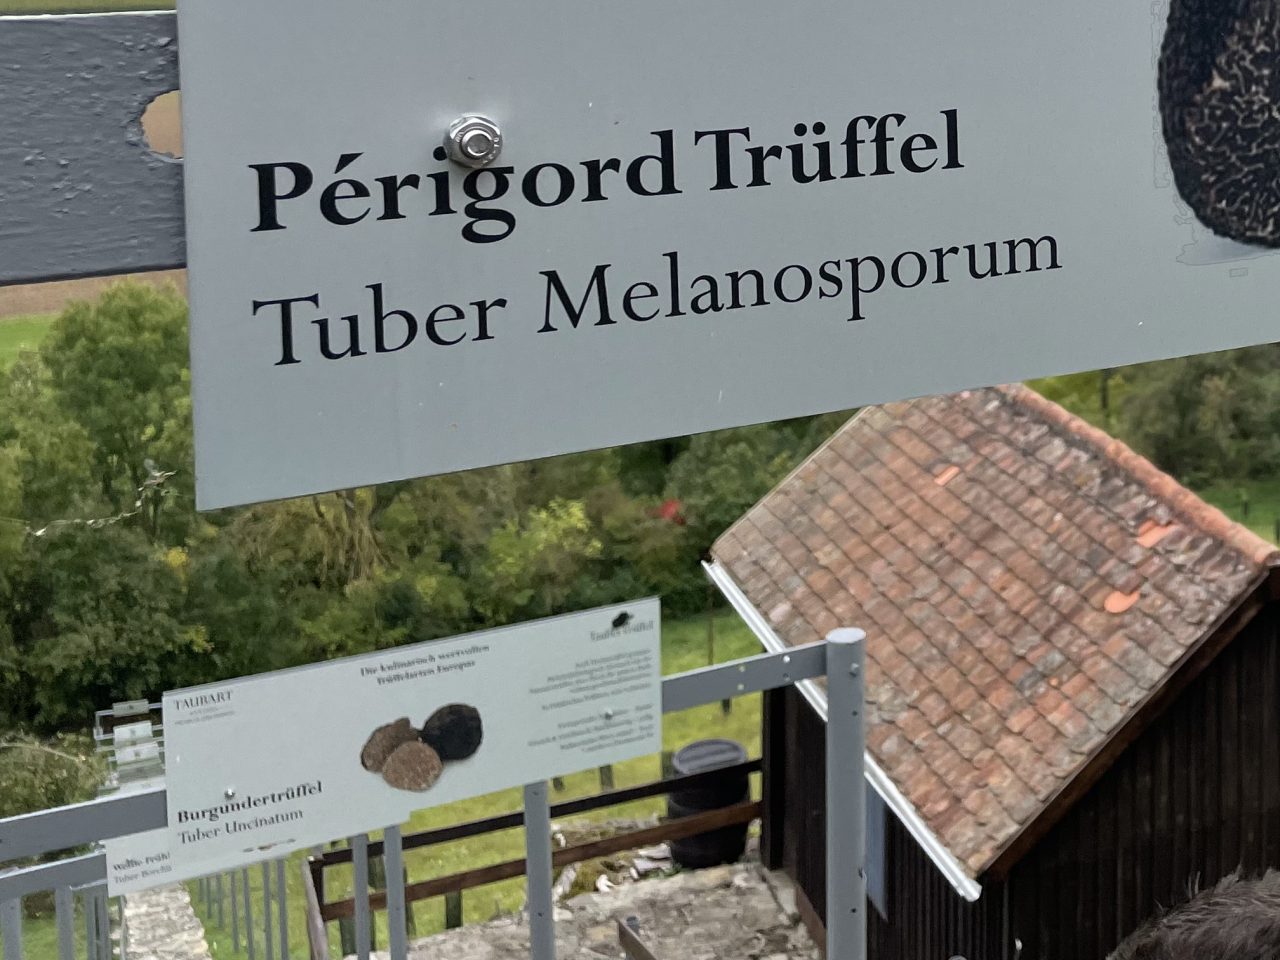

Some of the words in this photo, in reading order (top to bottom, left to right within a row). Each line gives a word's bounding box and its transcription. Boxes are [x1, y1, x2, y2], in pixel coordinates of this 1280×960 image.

[247, 129, 682, 243] Périgord
[694, 109, 965, 191] Trüffel
[252, 283, 507, 366] Tuber
[537, 236, 1063, 333] Melanosporum
[177, 780, 322, 824] Burgundertrüffel
[177, 822, 218, 844] Tuber
[225, 809, 303, 835] Uncinatum
